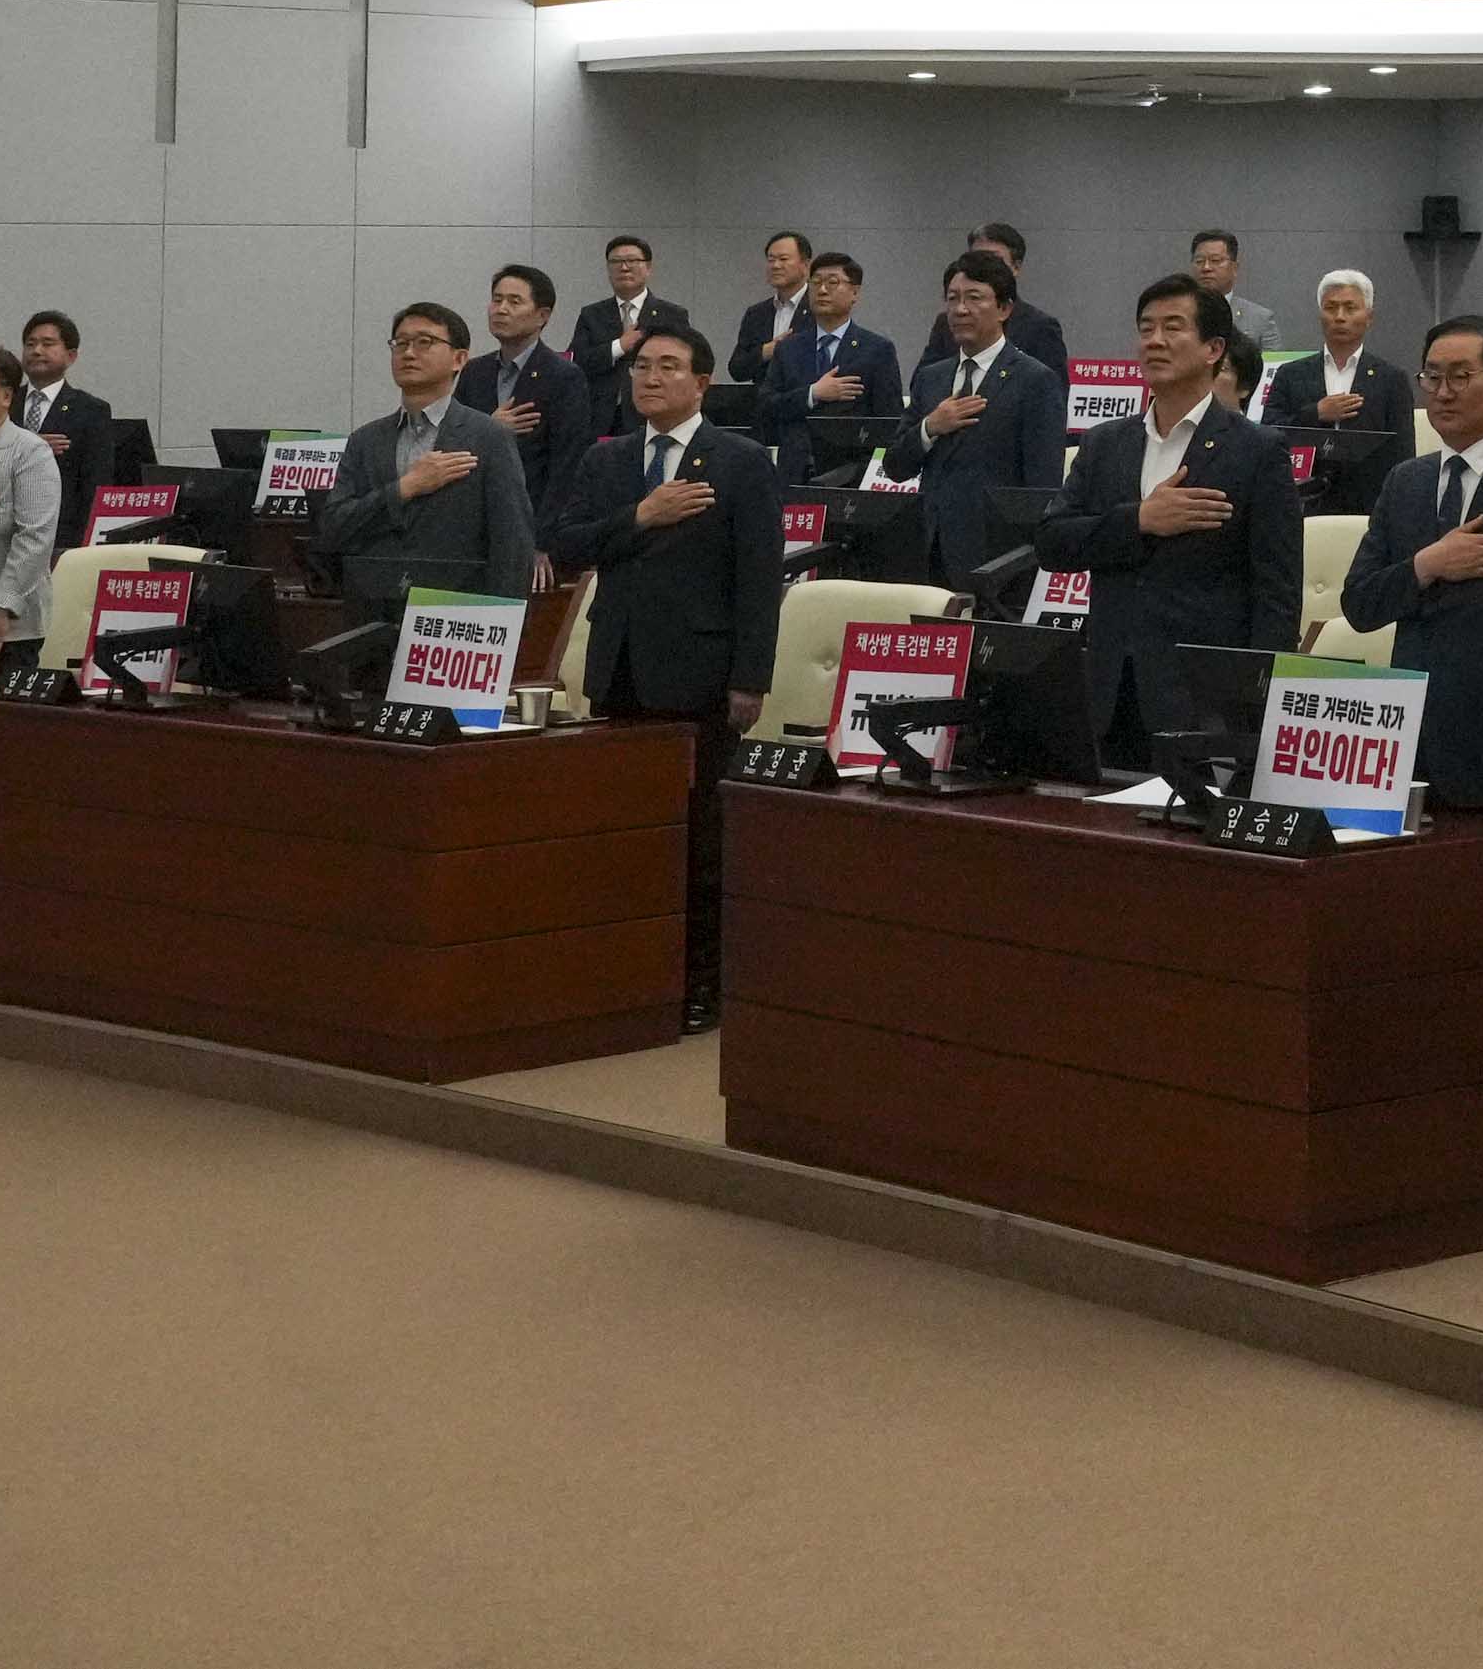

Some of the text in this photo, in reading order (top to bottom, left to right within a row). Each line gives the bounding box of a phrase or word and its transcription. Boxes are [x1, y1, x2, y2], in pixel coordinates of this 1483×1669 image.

[1073, 396, 1135, 419] 규탄한다!
[796, 513, 815, 530] 부결
[413, 616, 507, 646] 특검을 거부하는 자가
[856, 633, 958, 659] 채상병 특검법 부결
[404, 643, 502, 694] 범인이다!
[1281, 690, 1404, 731] 특검을 거부하는 자가
[1272, 724, 1399, 791] 범인이다!
